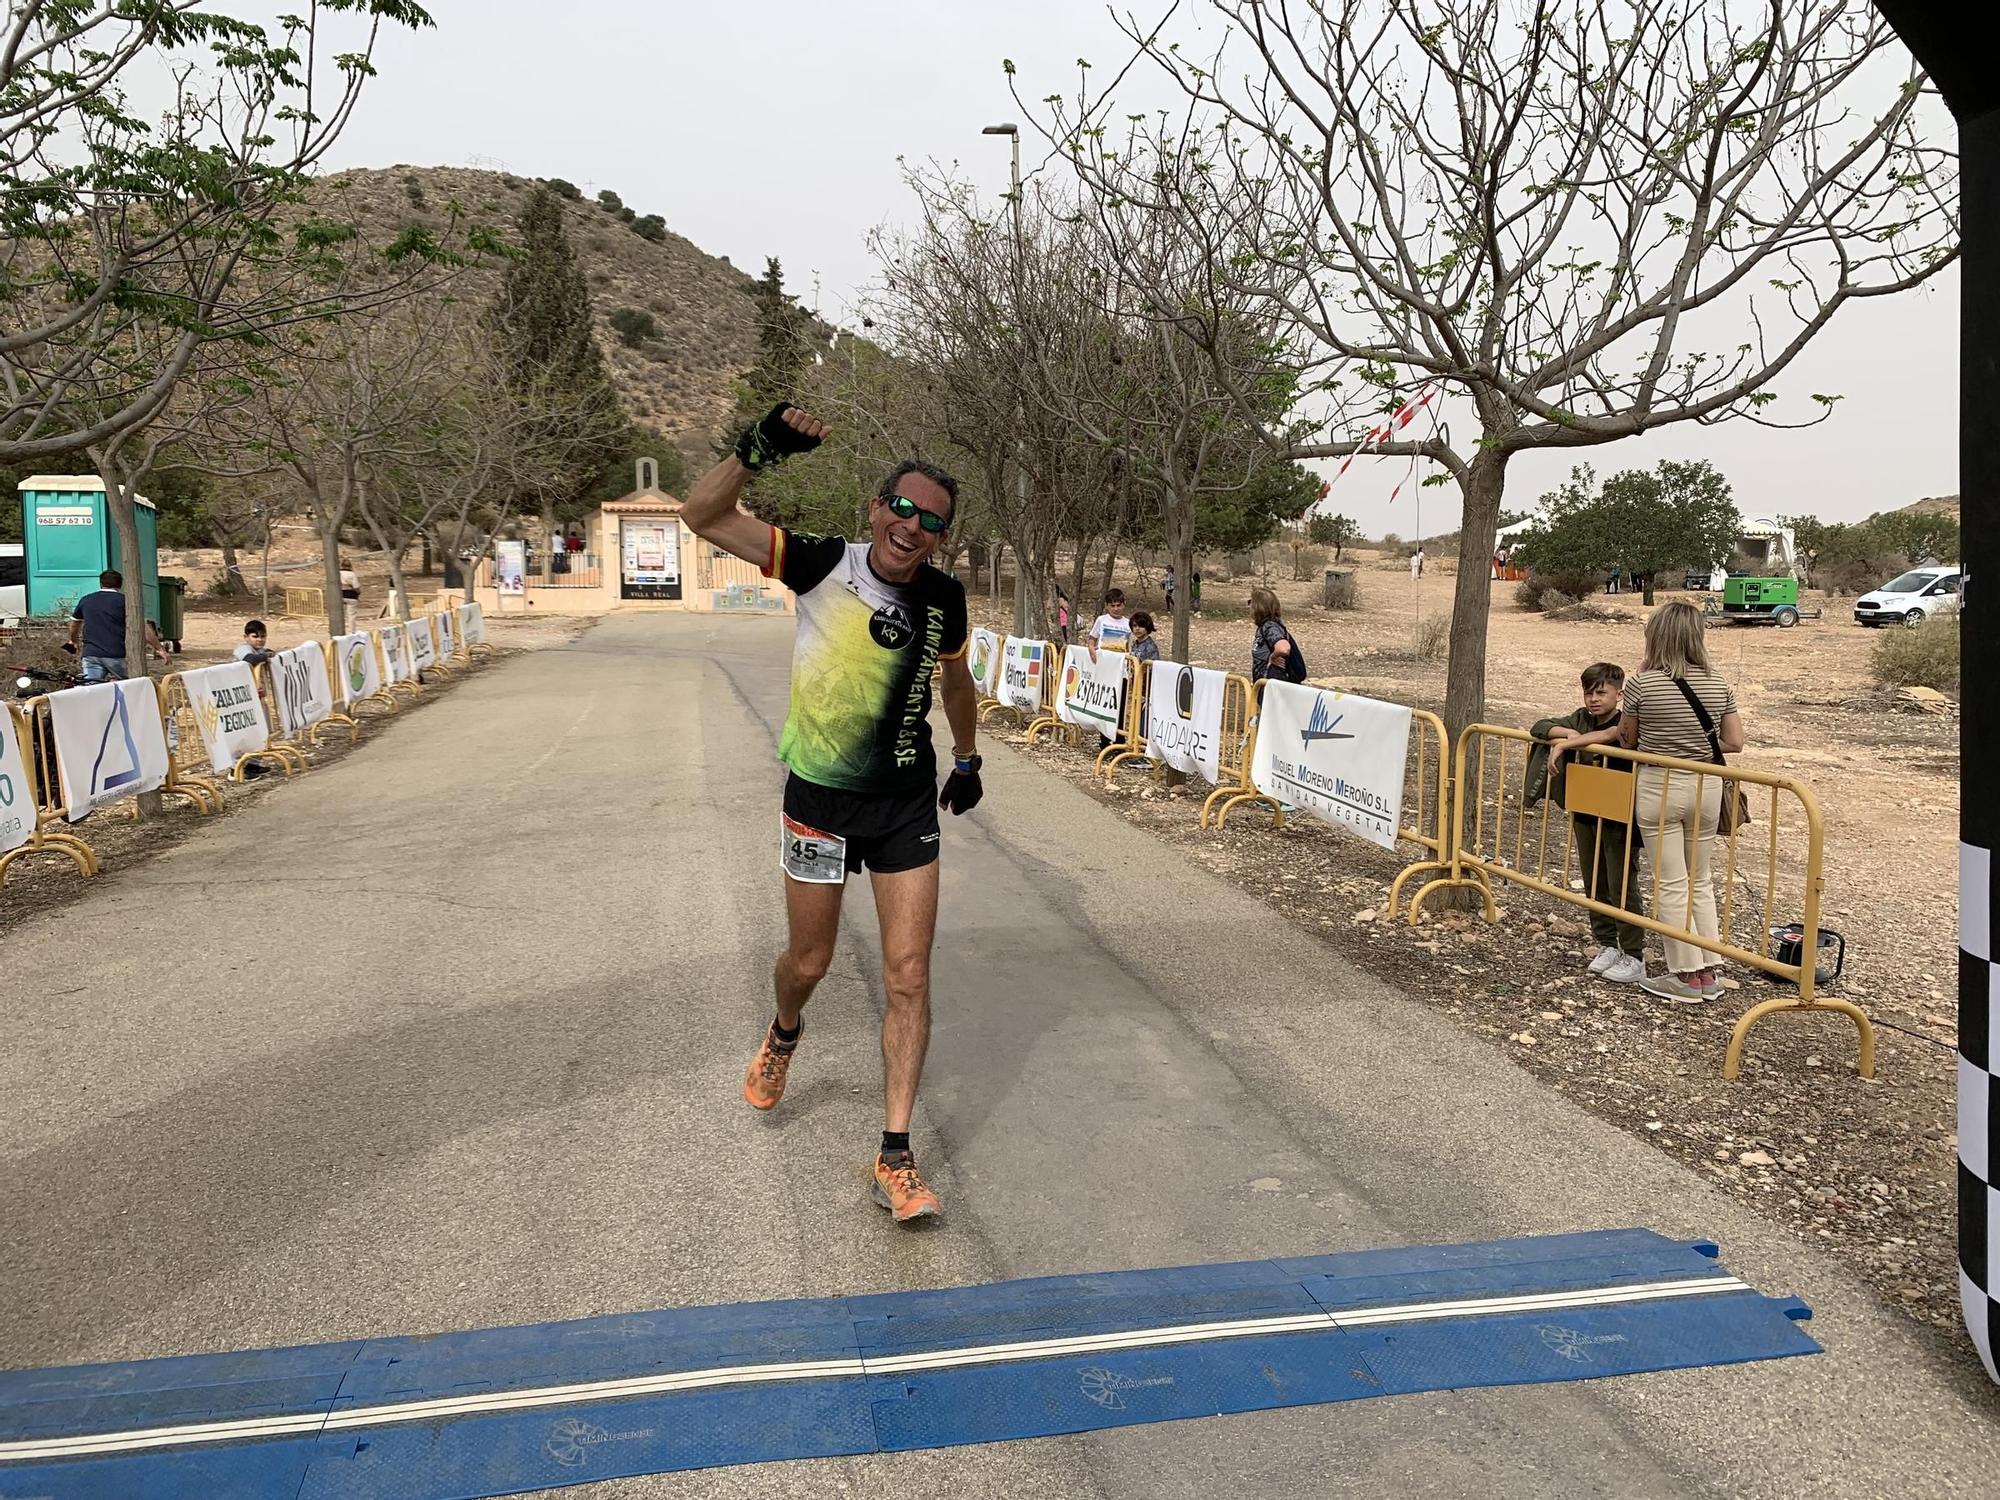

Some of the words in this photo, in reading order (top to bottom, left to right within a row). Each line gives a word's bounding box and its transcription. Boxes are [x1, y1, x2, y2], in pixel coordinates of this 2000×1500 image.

[55, 517, 66, 525] 57
[82, 517, 92, 525] 10
[903, 605, 944, 727] KAMPAMENTO
[1077, 679, 1118, 713] esparza
[893, 730, 918, 769] BASE
[1271, 753, 1296, 778] MIGUEL
[1297, 764, 1334, 792] MORENO
[1335, 777, 1375, 808] MEROÑO
[1374, 796, 1393, 815] S.L.
[1270, 777, 1317, 807] SANIDAD
[1327, 802, 1392, 837] VEGETAL
[791, 839, 818, 860] 45
